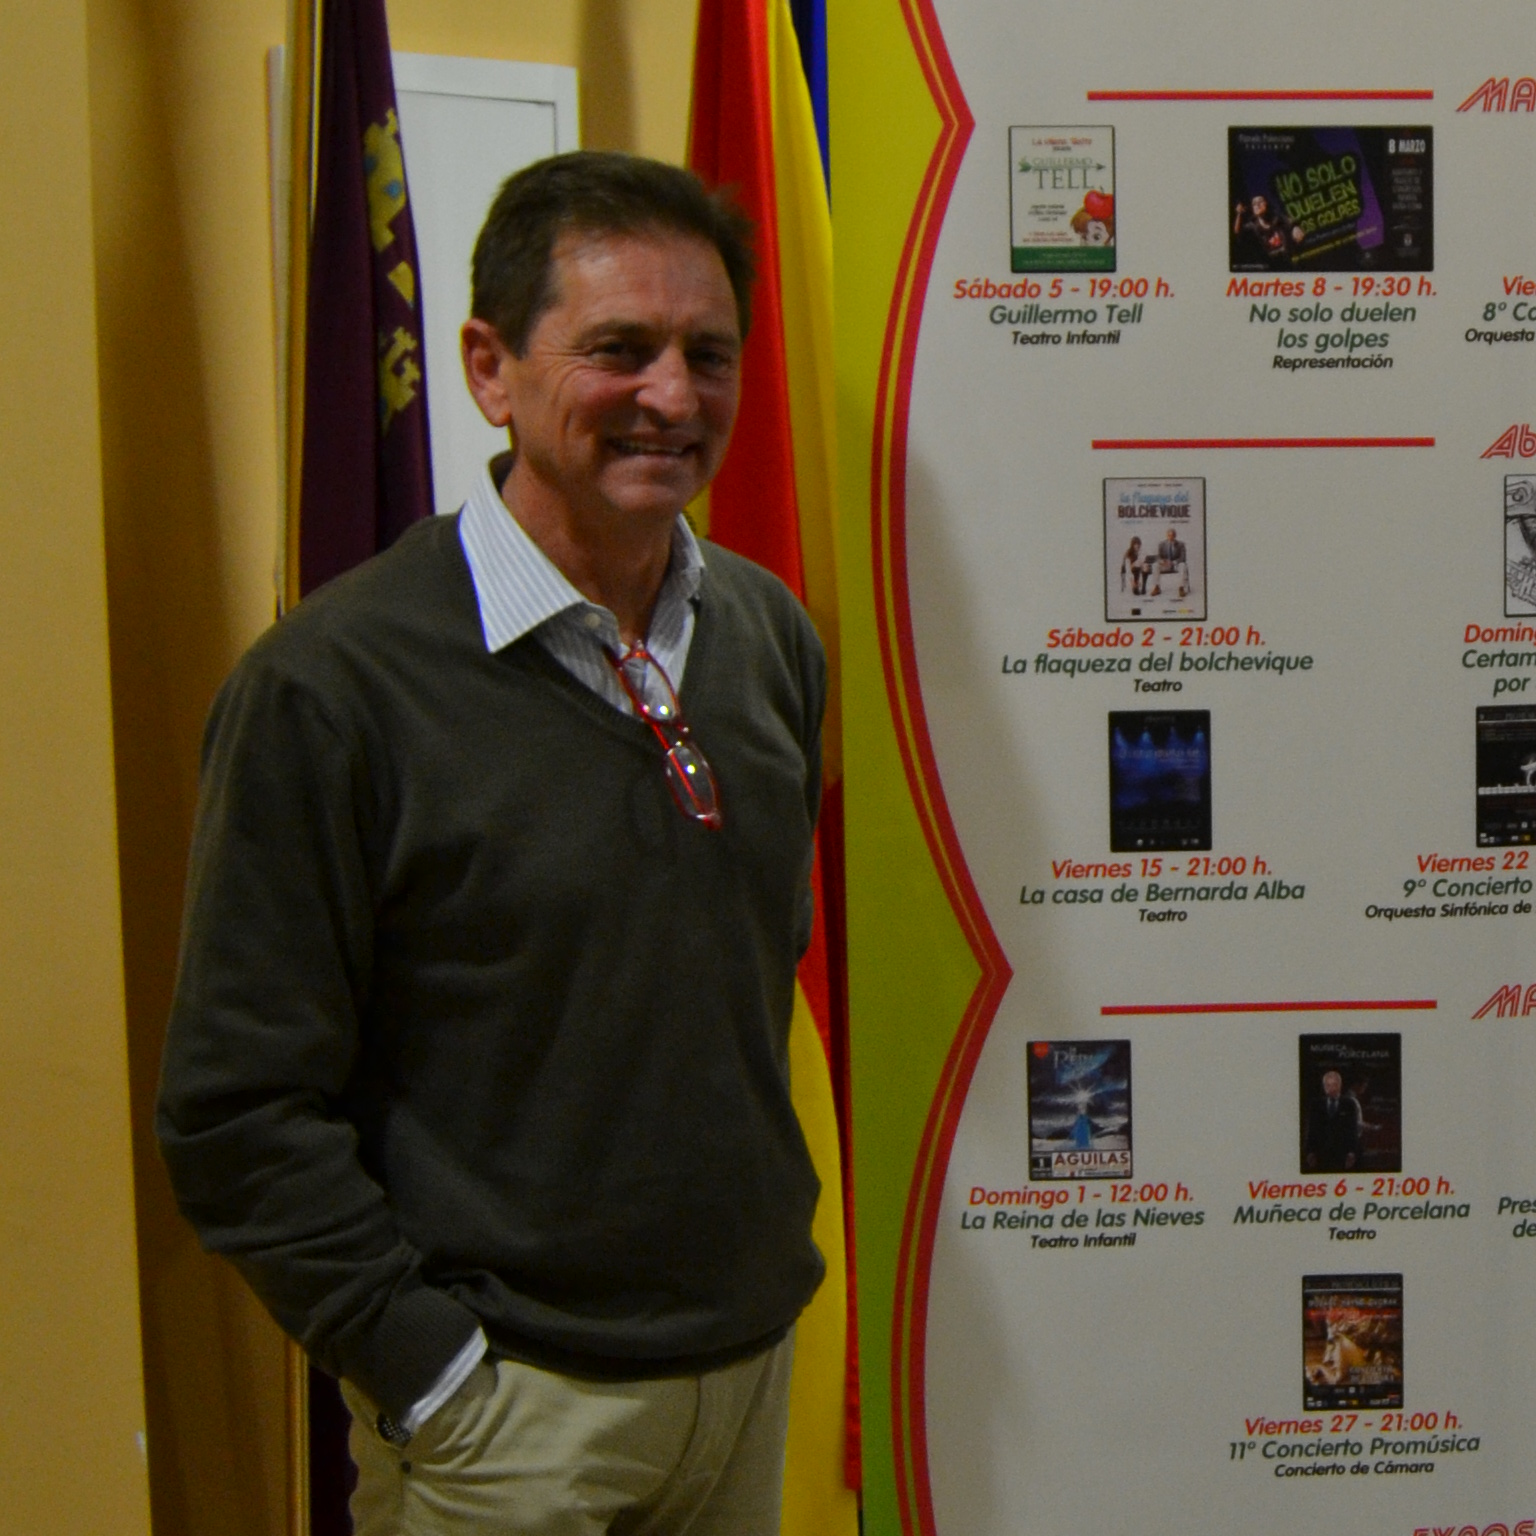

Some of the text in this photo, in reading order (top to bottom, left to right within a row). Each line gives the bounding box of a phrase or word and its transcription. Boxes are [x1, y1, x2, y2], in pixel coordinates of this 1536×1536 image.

[1035, 168, 1095, 190] TELL
[1276, 155, 1356, 201] NO SOLO
[1286, 179, 1358, 220] DUELEN
[953, 278, 1041, 299] Sábado
[1048, 278, 1062, 298] 5
[1089, 277, 1148, 298] 19:00
[1154, 277, 1174, 297] h.
[989, 303, 1143, 324] Guillermo Tell
[1249, 302, 1416, 322] No solo duelen
[1012, 330, 1120, 345] Teatro Infantil
[1277, 328, 1389, 353] los golpes
[1465, 328, 1535, 345] Orquesta
[1272, 354, 1393, 372] Representación
[1117, 504, 1191, 518] BOLCHEVIQUE
[1002, 651, 1313, 678] La flaqueza del bolchevique
[1134, 679, 1182, 692] Teatro
[1493, 678, 1530, 697] por
[1019, 880, 1305, 905] La casa de Bernarda Alba
[1432, 877, 1533, 897] Concierto
[961, 1207, 1204, 1229] La Reina de las Nieves
[1233, 1201, 1470, 1224] Muñeca de Porcelana
[1031, 1233, 1136, 1249] Teatro Infantil
[1262, 1439, 1363, 1459] Concierto
[1370, 1435, 1480, 1456] Promúsica
